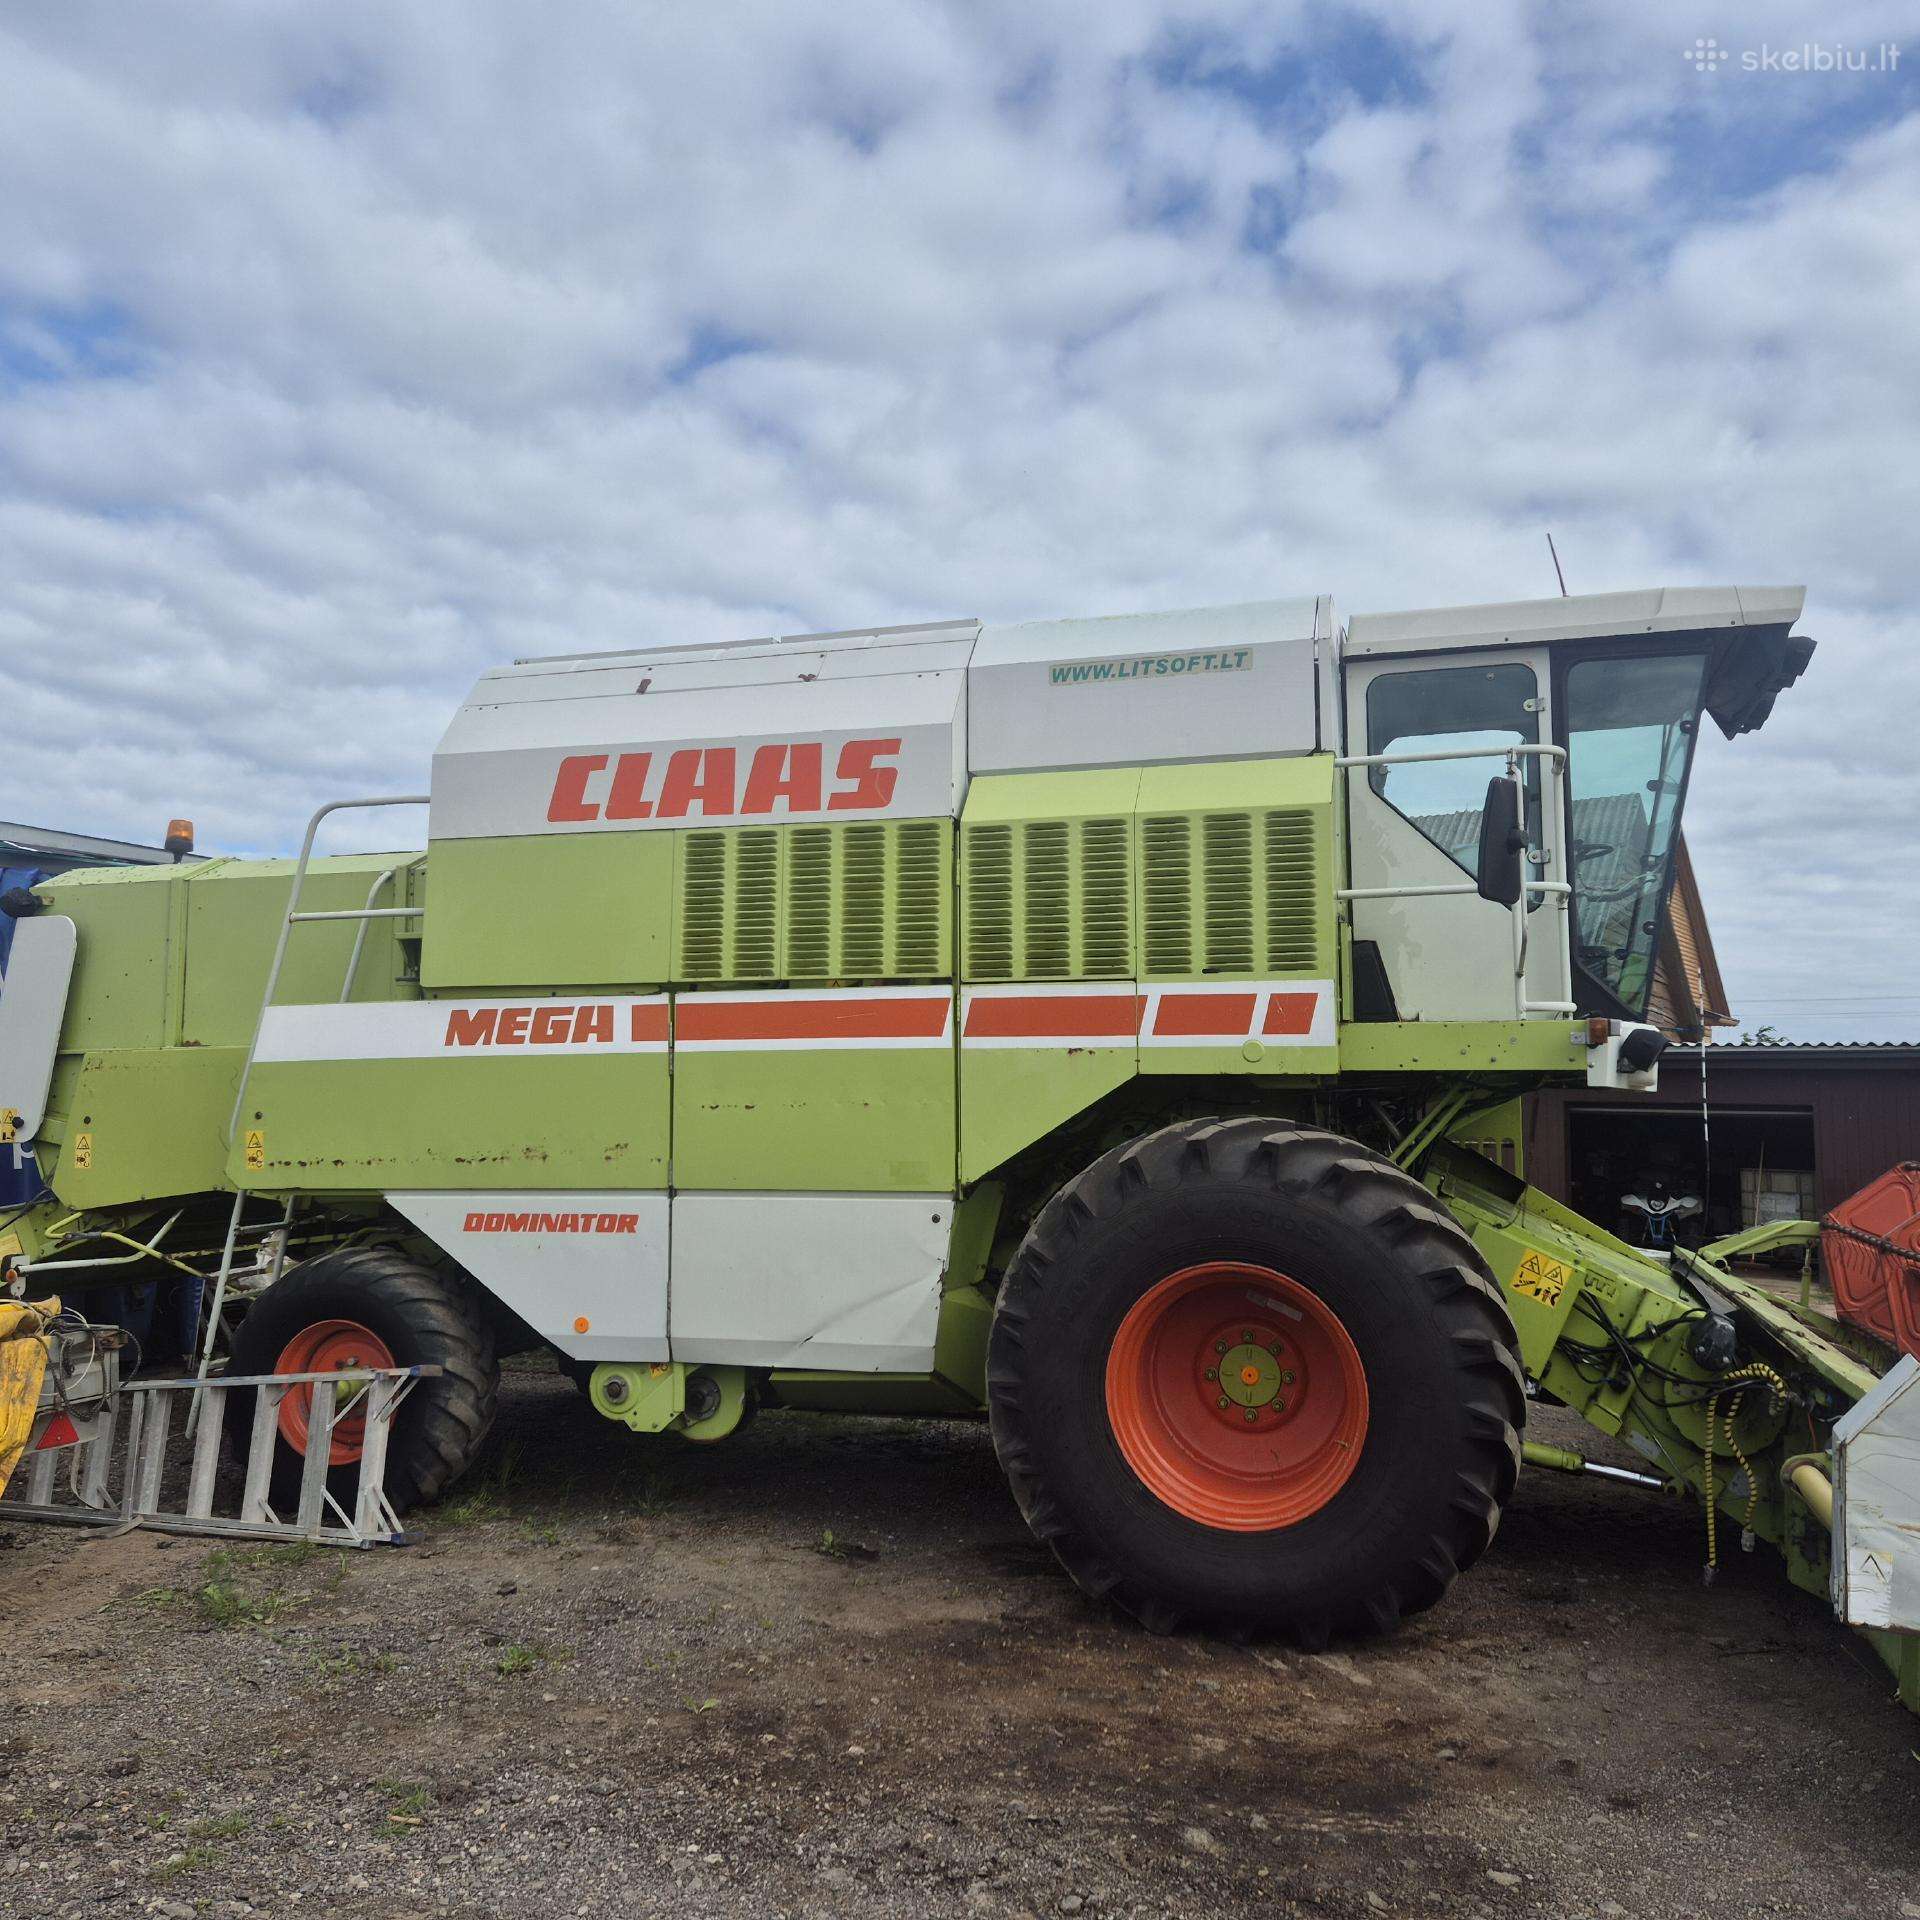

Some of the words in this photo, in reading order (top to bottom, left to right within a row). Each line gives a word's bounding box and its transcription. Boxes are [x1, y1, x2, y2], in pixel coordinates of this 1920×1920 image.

[1052, 651, 1249, 683] WWW.LITSOFT.LT
[547, 738, 902, 823] CLAAS
[444, 1005, 614, 1046] MEGA
[463, 1213, 640, 1233] DOMINATOR
